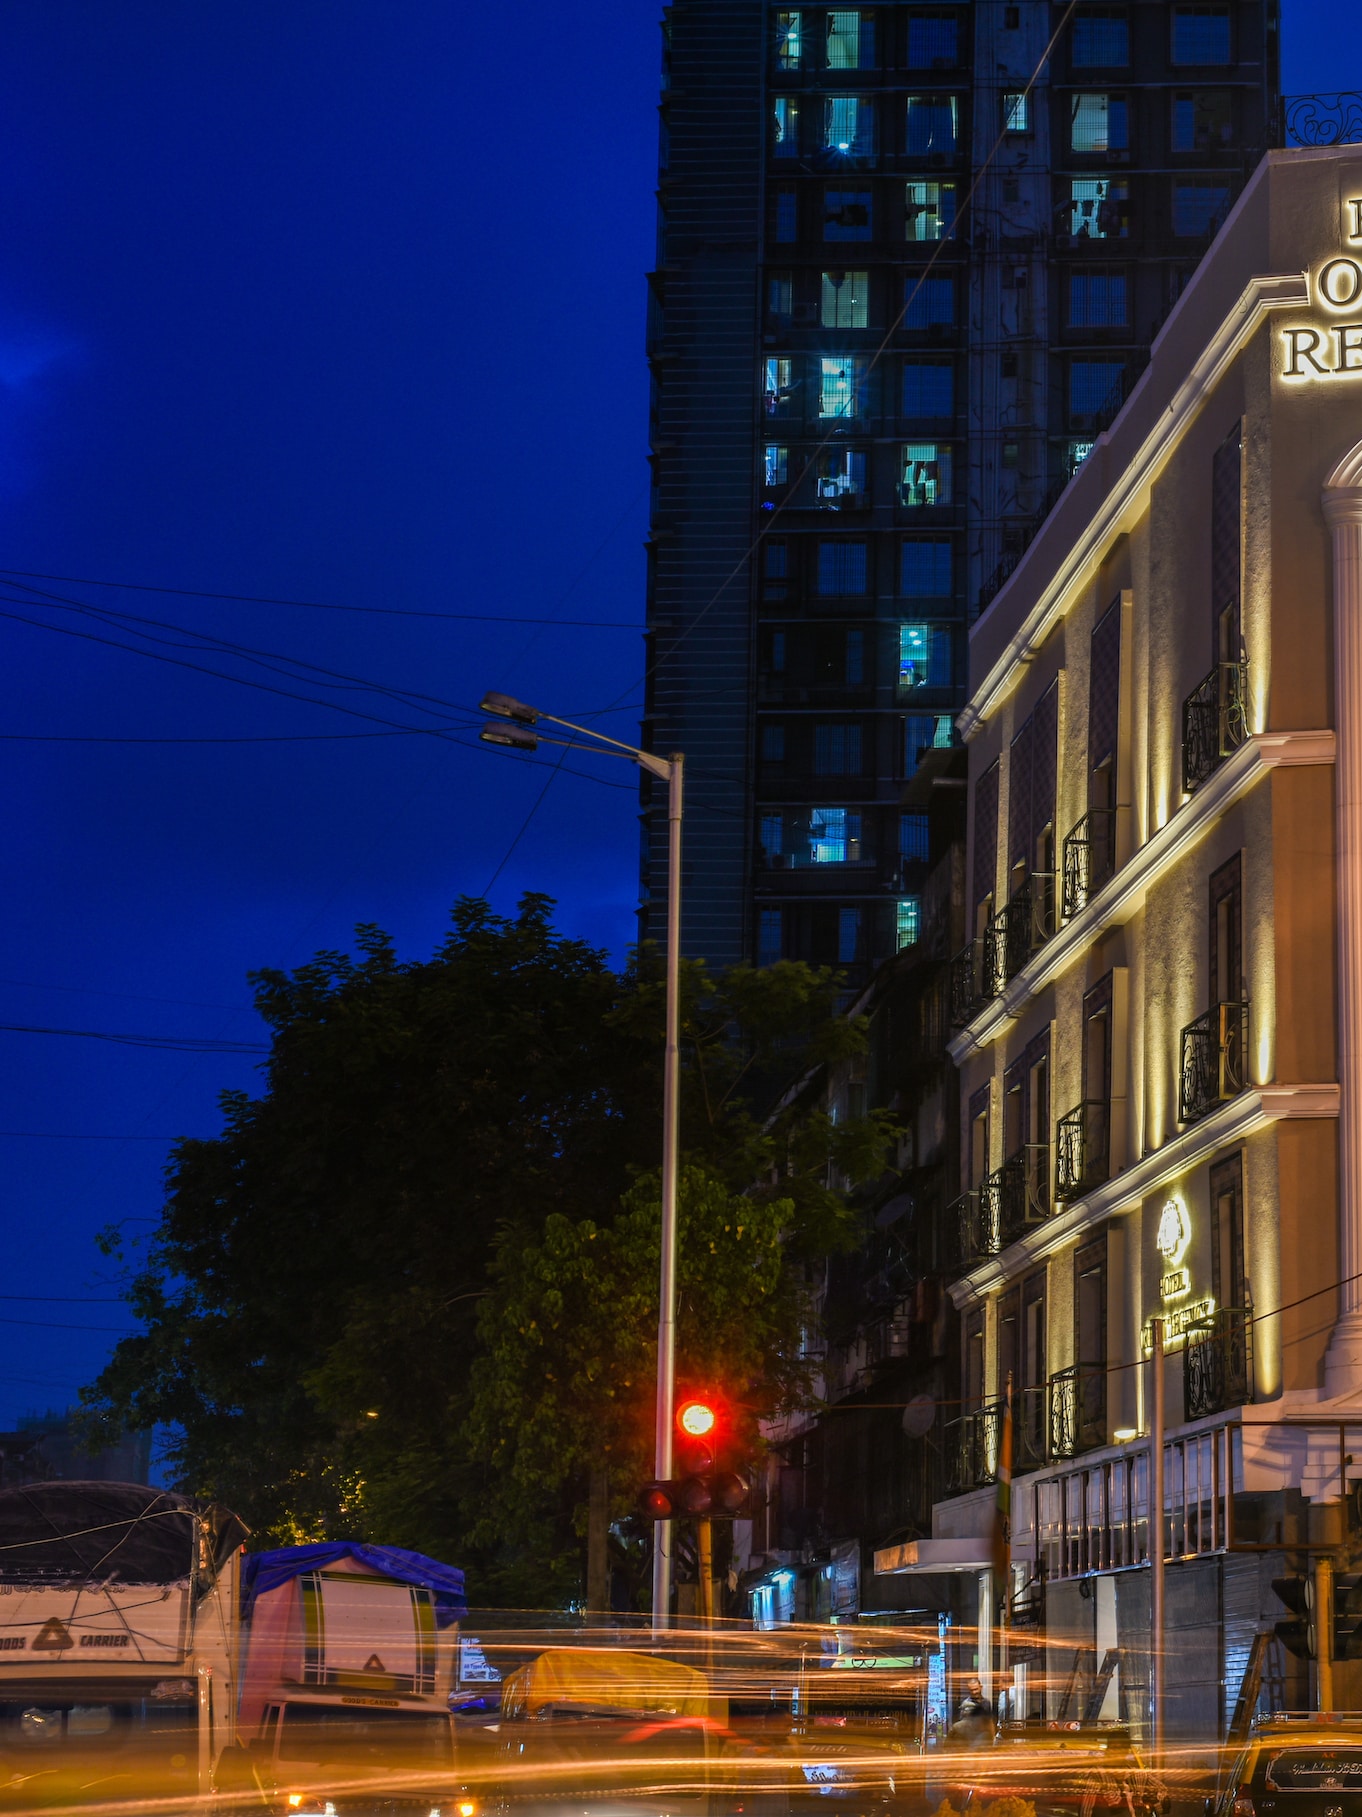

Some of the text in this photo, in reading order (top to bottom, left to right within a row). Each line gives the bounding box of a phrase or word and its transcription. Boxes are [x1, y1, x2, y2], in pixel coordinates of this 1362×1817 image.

[1158, 1269, 1188, 1298] HOTEL
[80, 1635, 129, 1647] CARRIER
[1049, 1721, 1080, 1731] A/C
